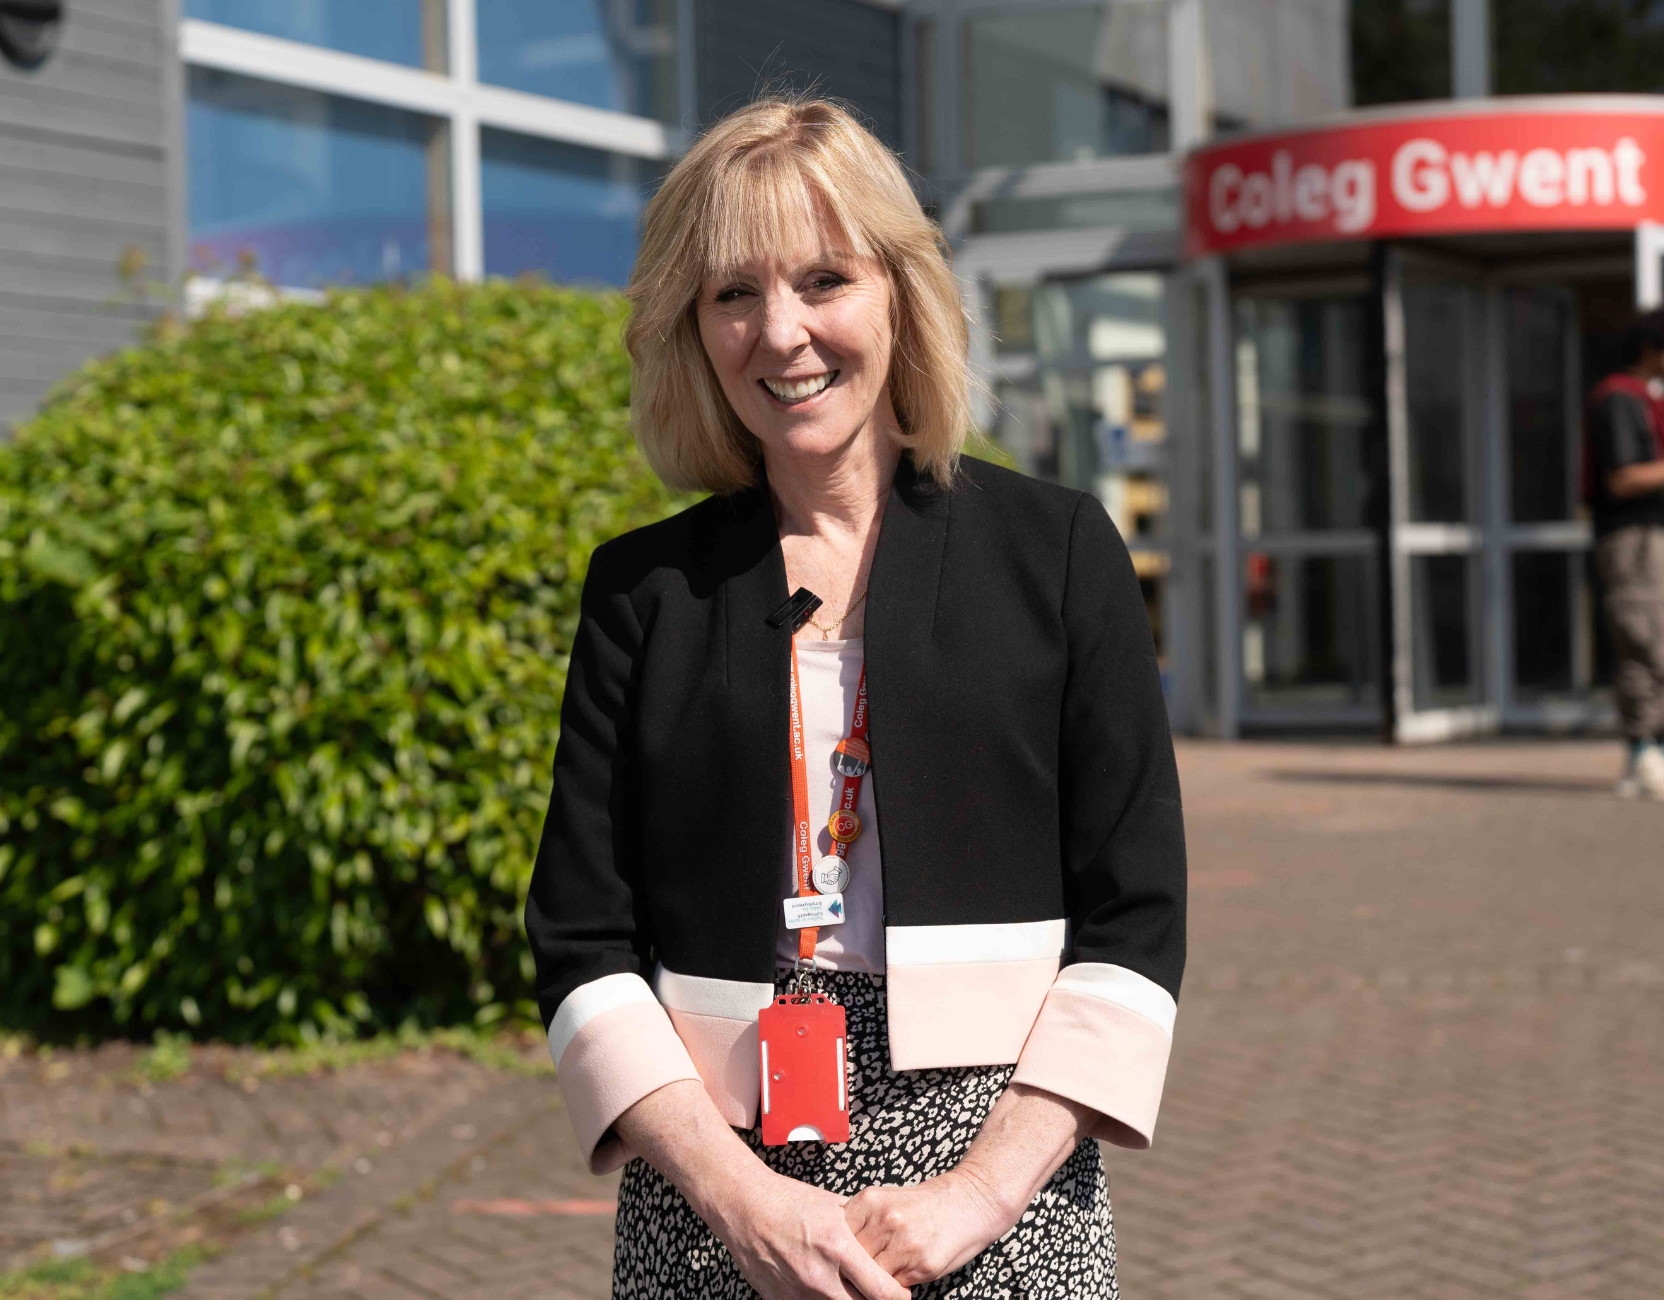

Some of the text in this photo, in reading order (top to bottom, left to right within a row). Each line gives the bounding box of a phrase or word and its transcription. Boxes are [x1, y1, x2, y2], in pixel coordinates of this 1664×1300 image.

[1208, 136, 1648, 234] Coleg Gwent
[854, 698, 868, 728] Coleg
[837, 820, 853, 831] CG
[799, 822, 812, 890] Coleg Gwent
